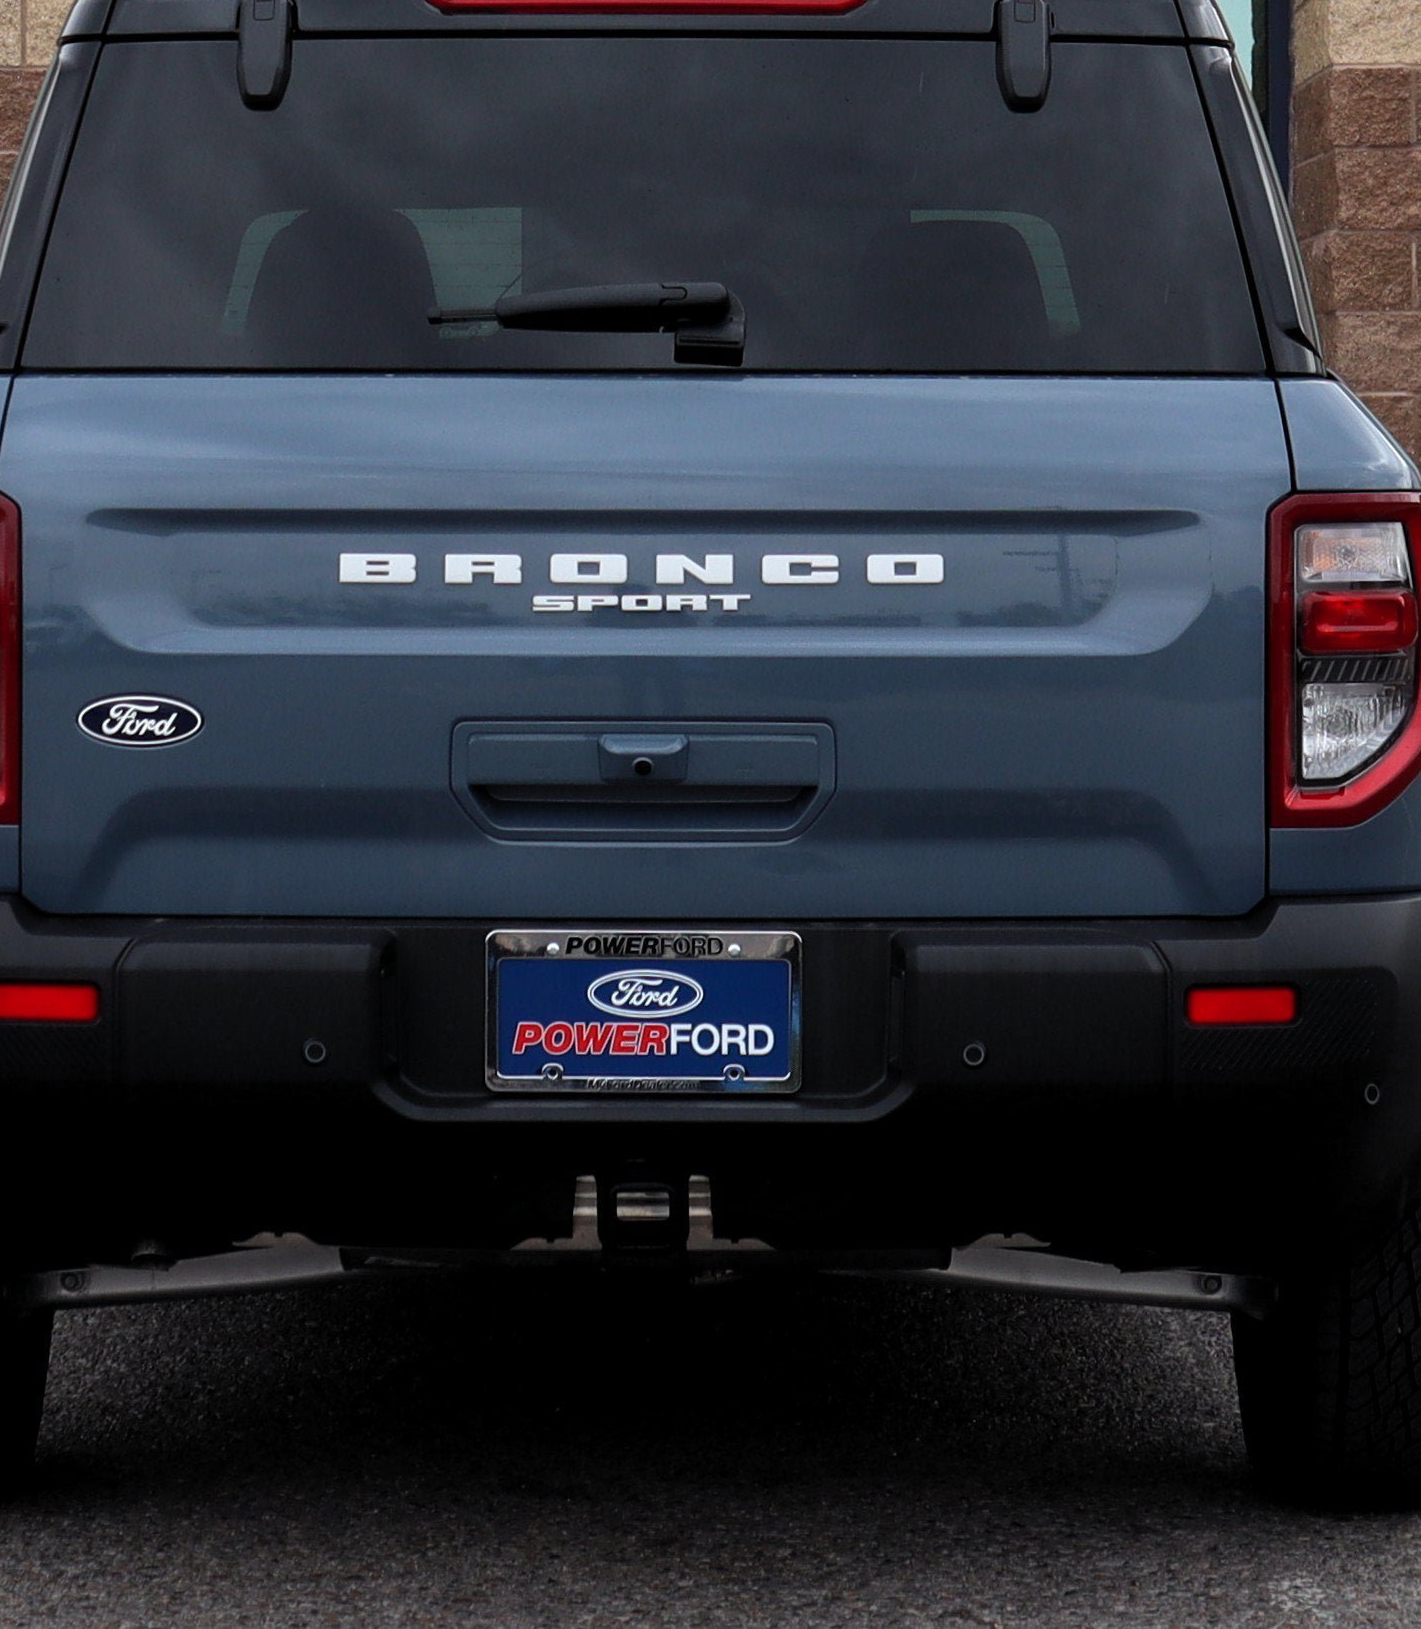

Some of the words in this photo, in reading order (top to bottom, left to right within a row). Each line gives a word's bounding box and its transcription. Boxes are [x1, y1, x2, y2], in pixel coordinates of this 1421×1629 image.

[338, 551, 945, 585] BRONCO
[531, 593, 752, 613] SPORT
[101, 702, 179, 737] Ford
[610, 977, 680, 1008] Ford
